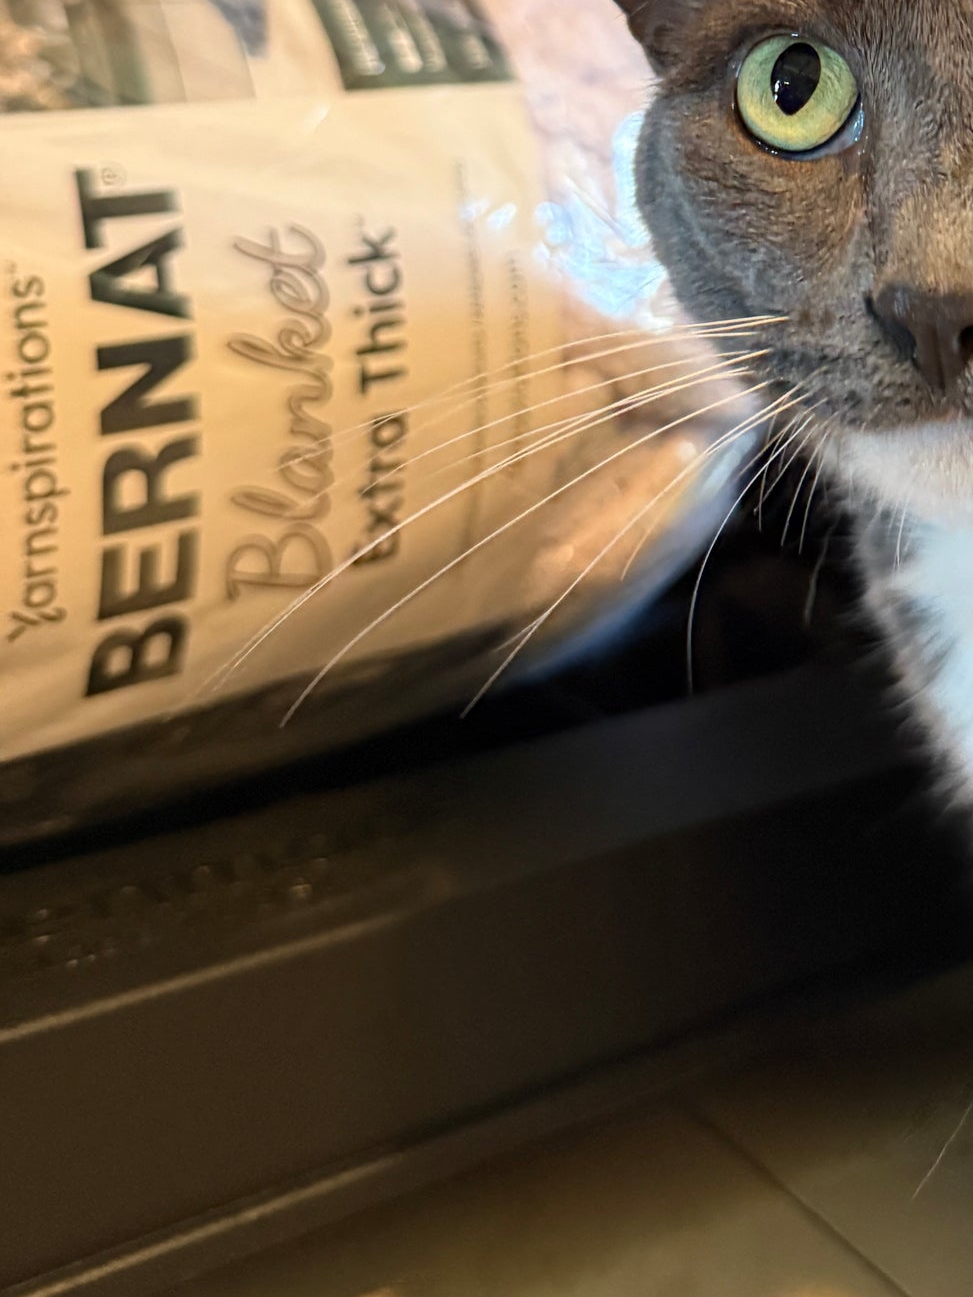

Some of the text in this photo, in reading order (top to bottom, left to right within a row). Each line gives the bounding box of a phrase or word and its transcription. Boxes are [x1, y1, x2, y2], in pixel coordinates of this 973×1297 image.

[8, 273, 70, 643] Yarnspirations
[75, 167, 199, 698] BERNAT
[226, 220, 333, 600] Blanket
[347, 225, 407, 567] Extra Thick
